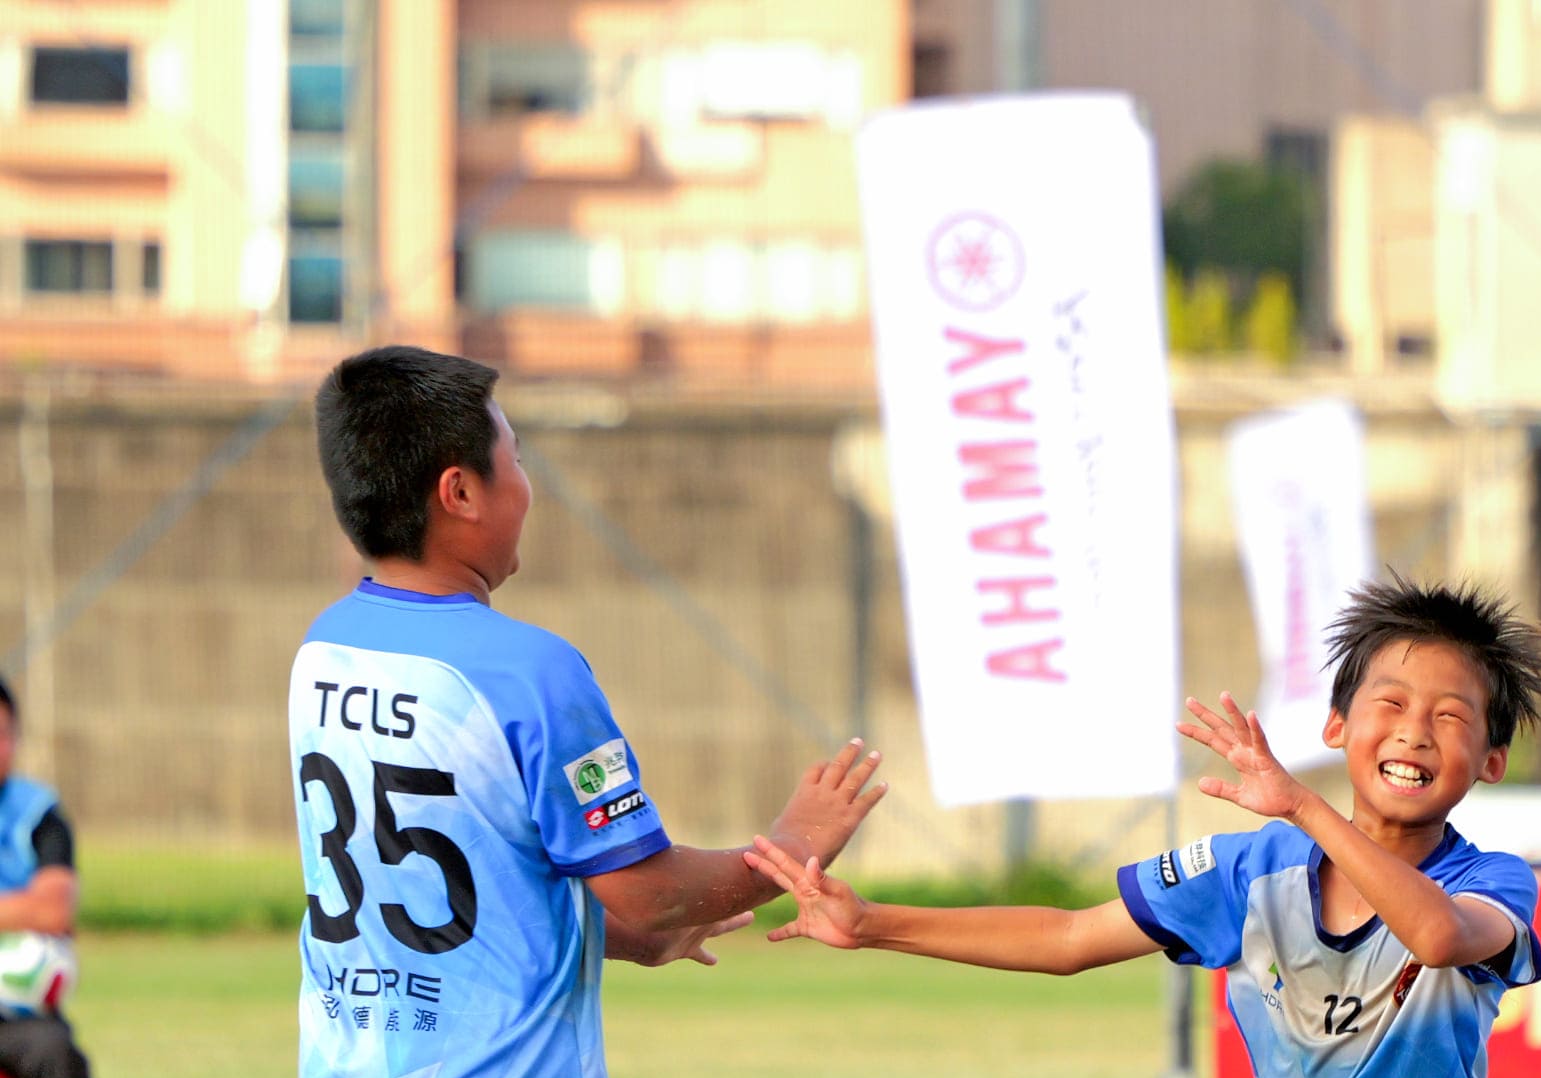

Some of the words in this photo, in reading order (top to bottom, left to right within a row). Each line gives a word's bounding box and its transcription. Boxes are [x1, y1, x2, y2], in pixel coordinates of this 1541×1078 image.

[314, 681, 418, 739] TCLS
[300, 751, 478, 955] 35
[326, 964, 442, 1003] HDRE
[1323, 994, 1363, 1035] 12
